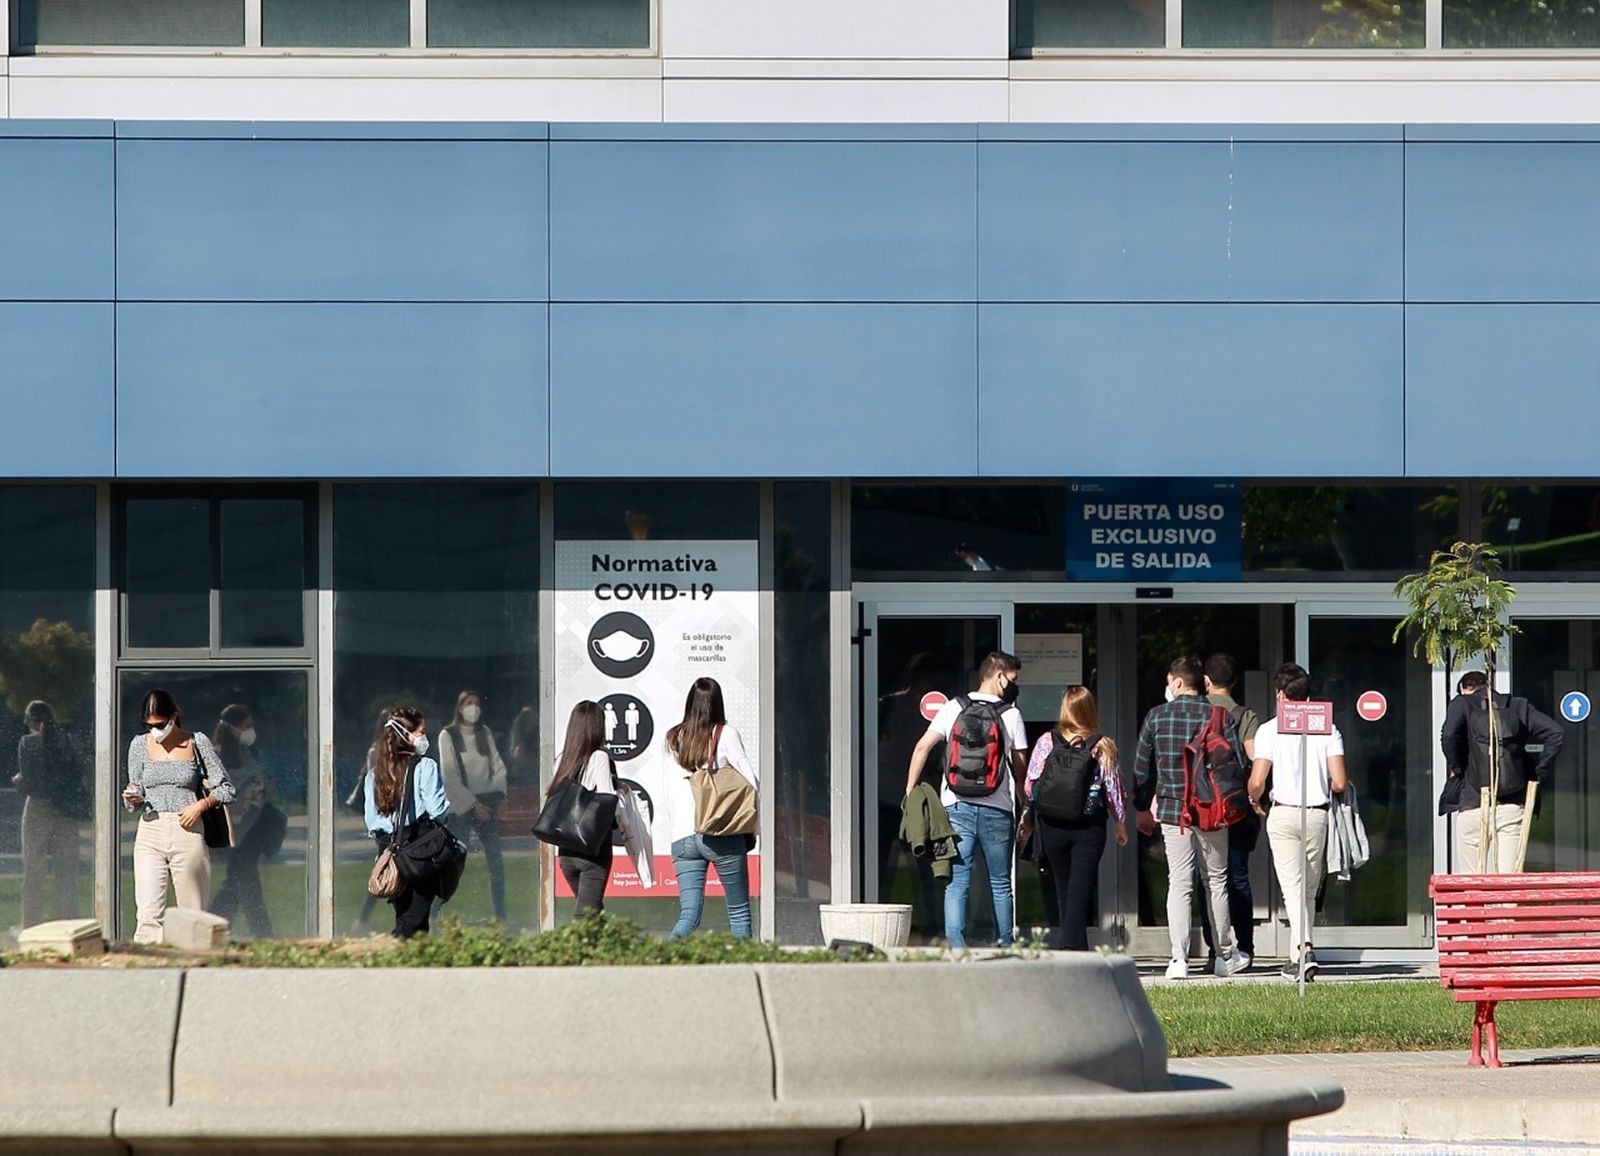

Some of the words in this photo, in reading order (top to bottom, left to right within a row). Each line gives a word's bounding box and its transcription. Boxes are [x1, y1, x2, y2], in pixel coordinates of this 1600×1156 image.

[1083, 504, 1171, 520] PUERTA
[1178, 504, 1224, 520] USO
[1091, 528, 1217, 544] EXCLUSIVO
[591, 554, 717, 572] Normativa
[1095, 552, 1125, 568] DE
[1131, 552, 1212, 568] SALIDA
[594, 583, 714, 601] COVID-19
[682, 633, 691, 641] Es
[693, 632, 732, 643] obligatorio
[715, 644, 724, 652] de
[613, 879, 625, 887] Rey
[625, 879, 638, 887] Juan
